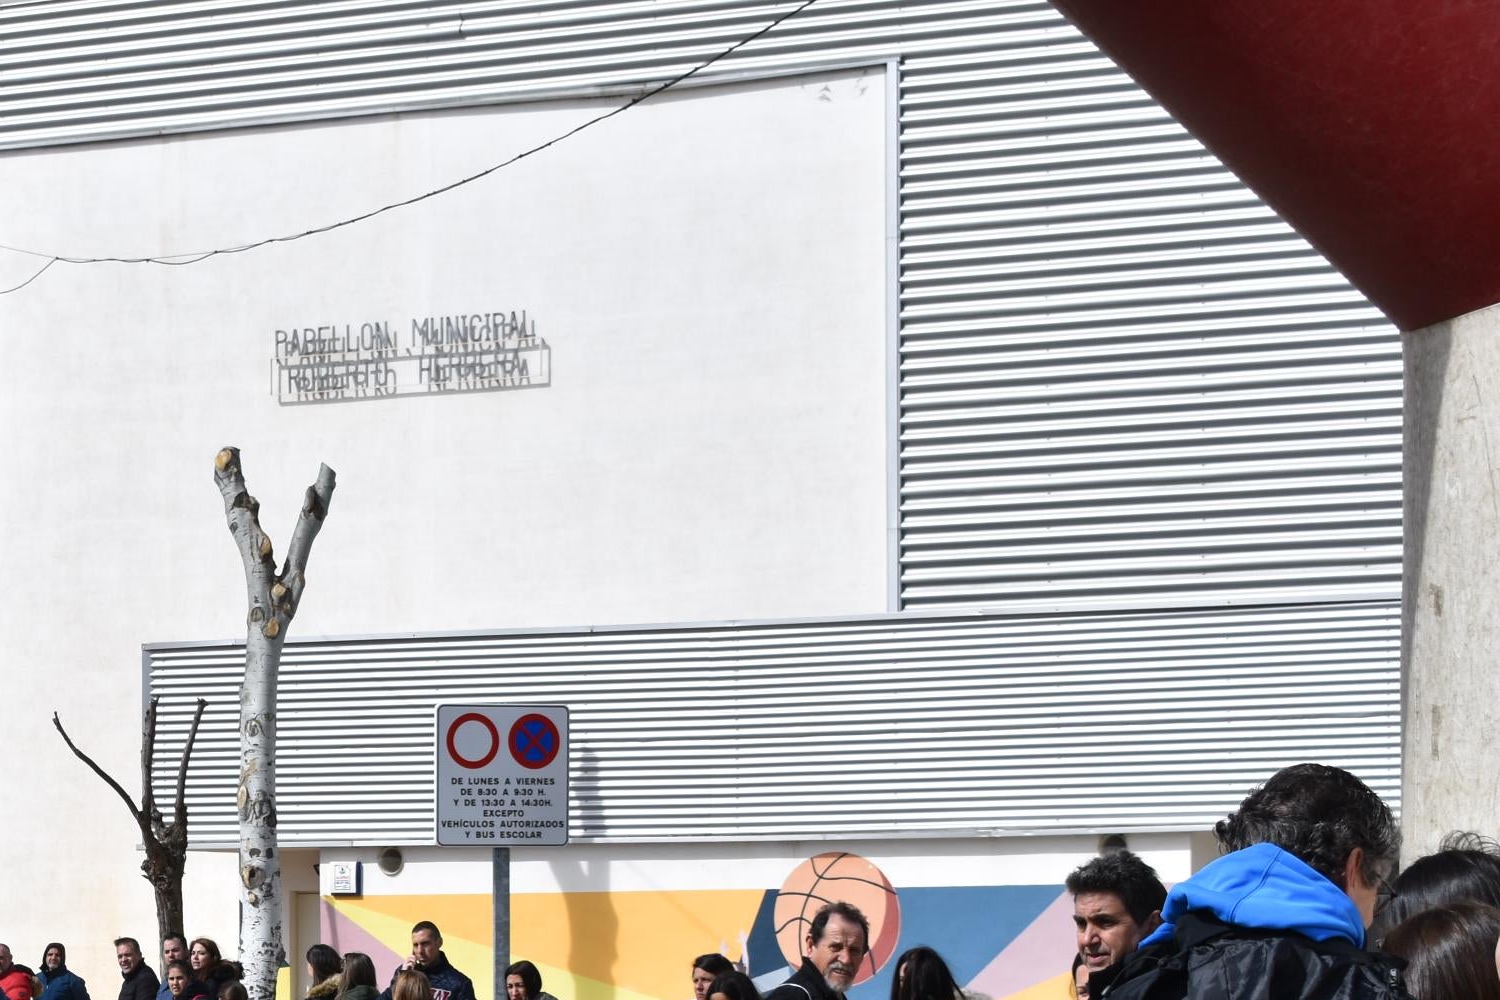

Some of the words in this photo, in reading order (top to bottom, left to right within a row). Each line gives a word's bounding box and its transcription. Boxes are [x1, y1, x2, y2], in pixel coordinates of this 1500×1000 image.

[412, 309, 533, 347] MUNICIPAL
[468, 777, 499, 785] LUNES
[505, 777, 511, 785] A
[515, 777, 555, 785] VIERNES
[460, 788, 473, 796] DE
[477, 788, 498, 796] 8:30
[502, 788, 509, 796] A
[513, 788, 534, 796] 9:30
[537, 788, 546, 796] H.
[453, 799, 460, 807] Y
[464, 799, 476, 807] DE
[481, 799, 505, 807] 13:30
[510, 799, 516, 807] A
[483, 809, 525, 817] EXCEPTO
[441, 819, 495, 828] VEHÍCULOS
[499, 820, 565, 828] AUTORIZADOS
[464, 831, 470, 839] Y
[475, 831, 495, 839] BUS
[500, 831, 542, 839] ESCOLAR
